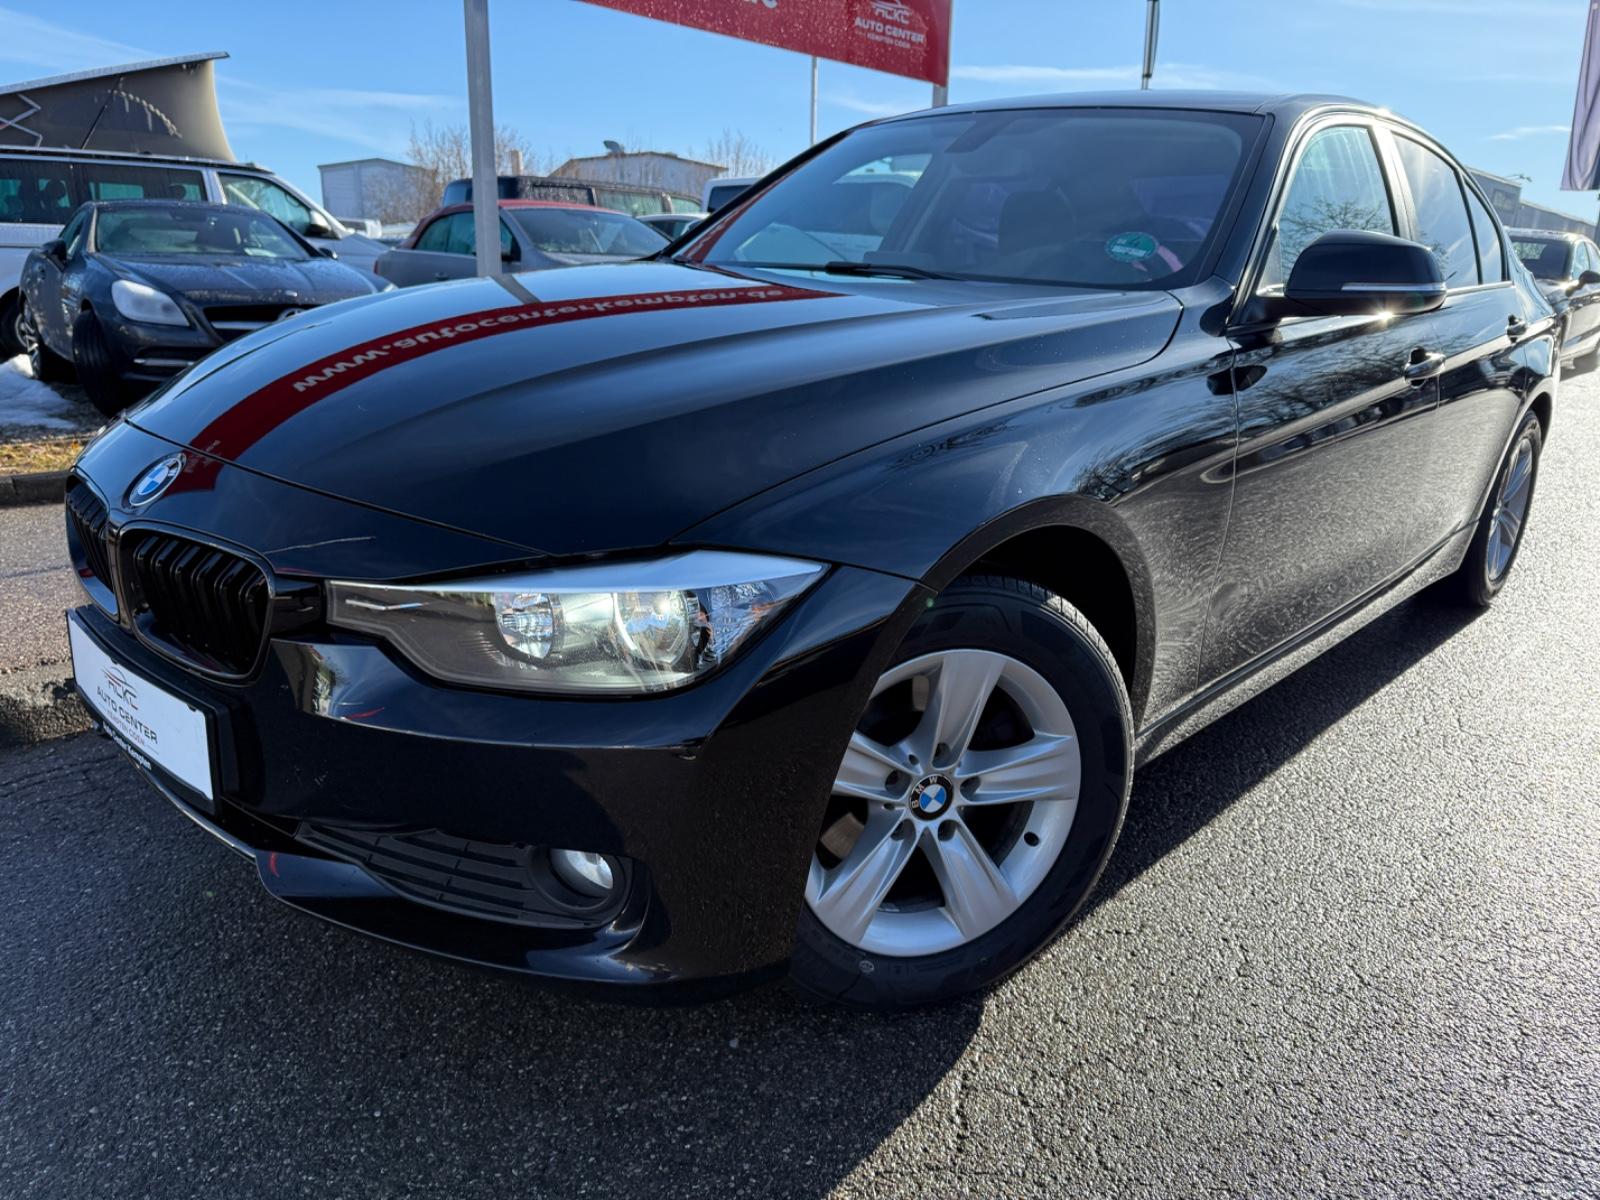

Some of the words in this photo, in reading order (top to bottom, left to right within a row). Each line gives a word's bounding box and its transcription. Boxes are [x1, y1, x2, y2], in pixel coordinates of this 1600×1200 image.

[855, 17, 883, 32] AUTO
[885, 25, 924, 43] CENTER
[97, 685, 117, 712] AUTO
[119, 706, 158, 744] CENTER
